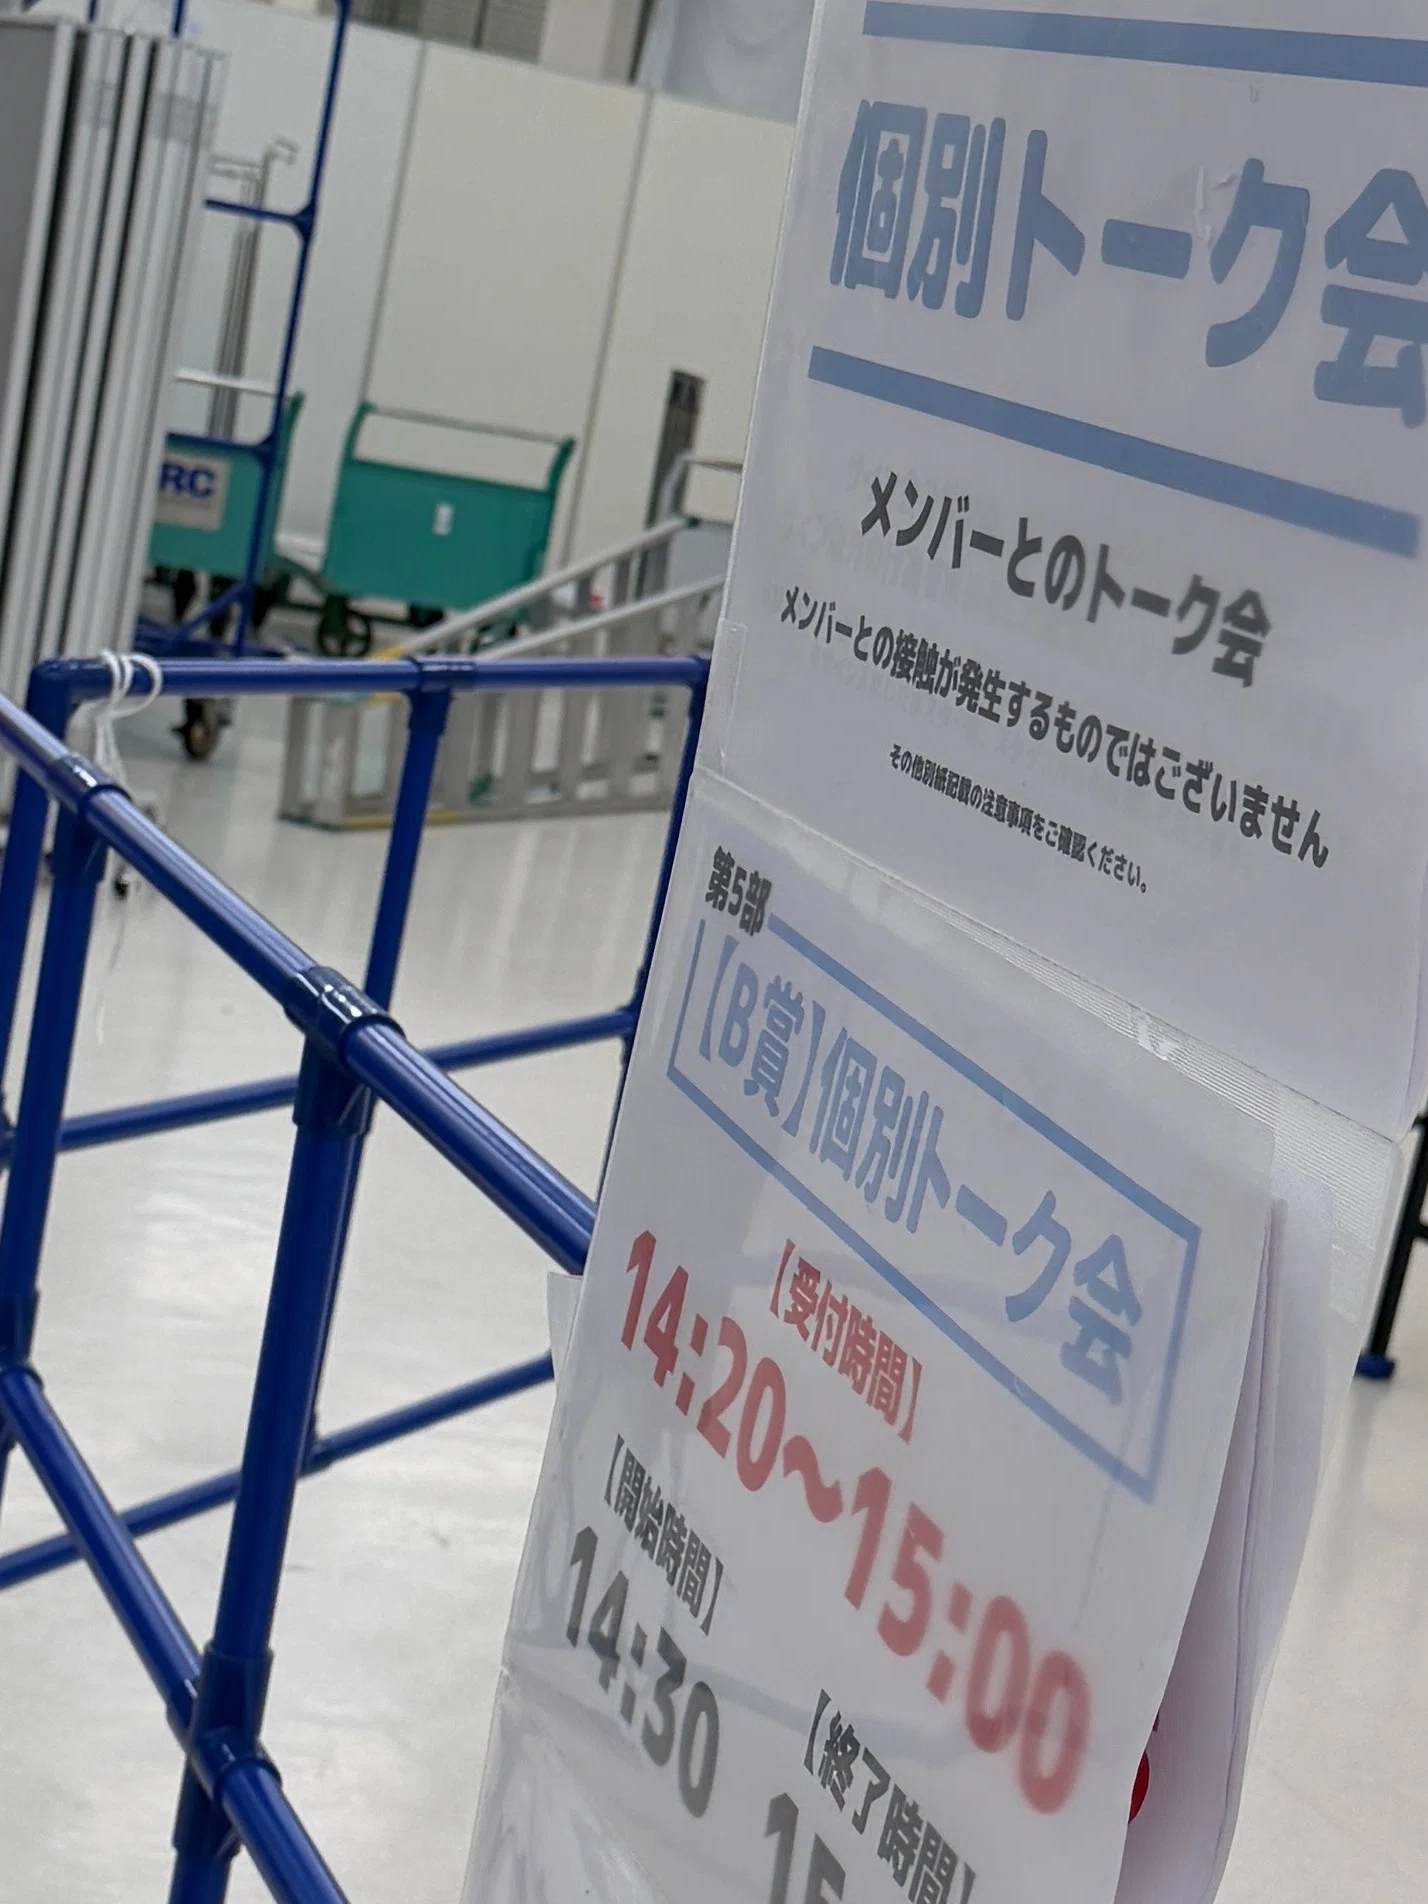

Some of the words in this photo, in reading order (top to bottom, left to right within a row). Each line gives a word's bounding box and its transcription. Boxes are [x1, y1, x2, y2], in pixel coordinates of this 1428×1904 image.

[859, 470, 1272, 687] メンバーとのトーク会
[780, 585, 1330, 869] メンバーとの接触が発生するものではございません
[704, 844, 773, 937] 第5部
[698, 934, 1143, 1405] 【B賞】個別トーク会
[768, 1238, 923, 1445] 【受付時間】
[604, 1434, 725, 1637] 【開始時間】
[567, 1525, 721, 1819] 14:30
